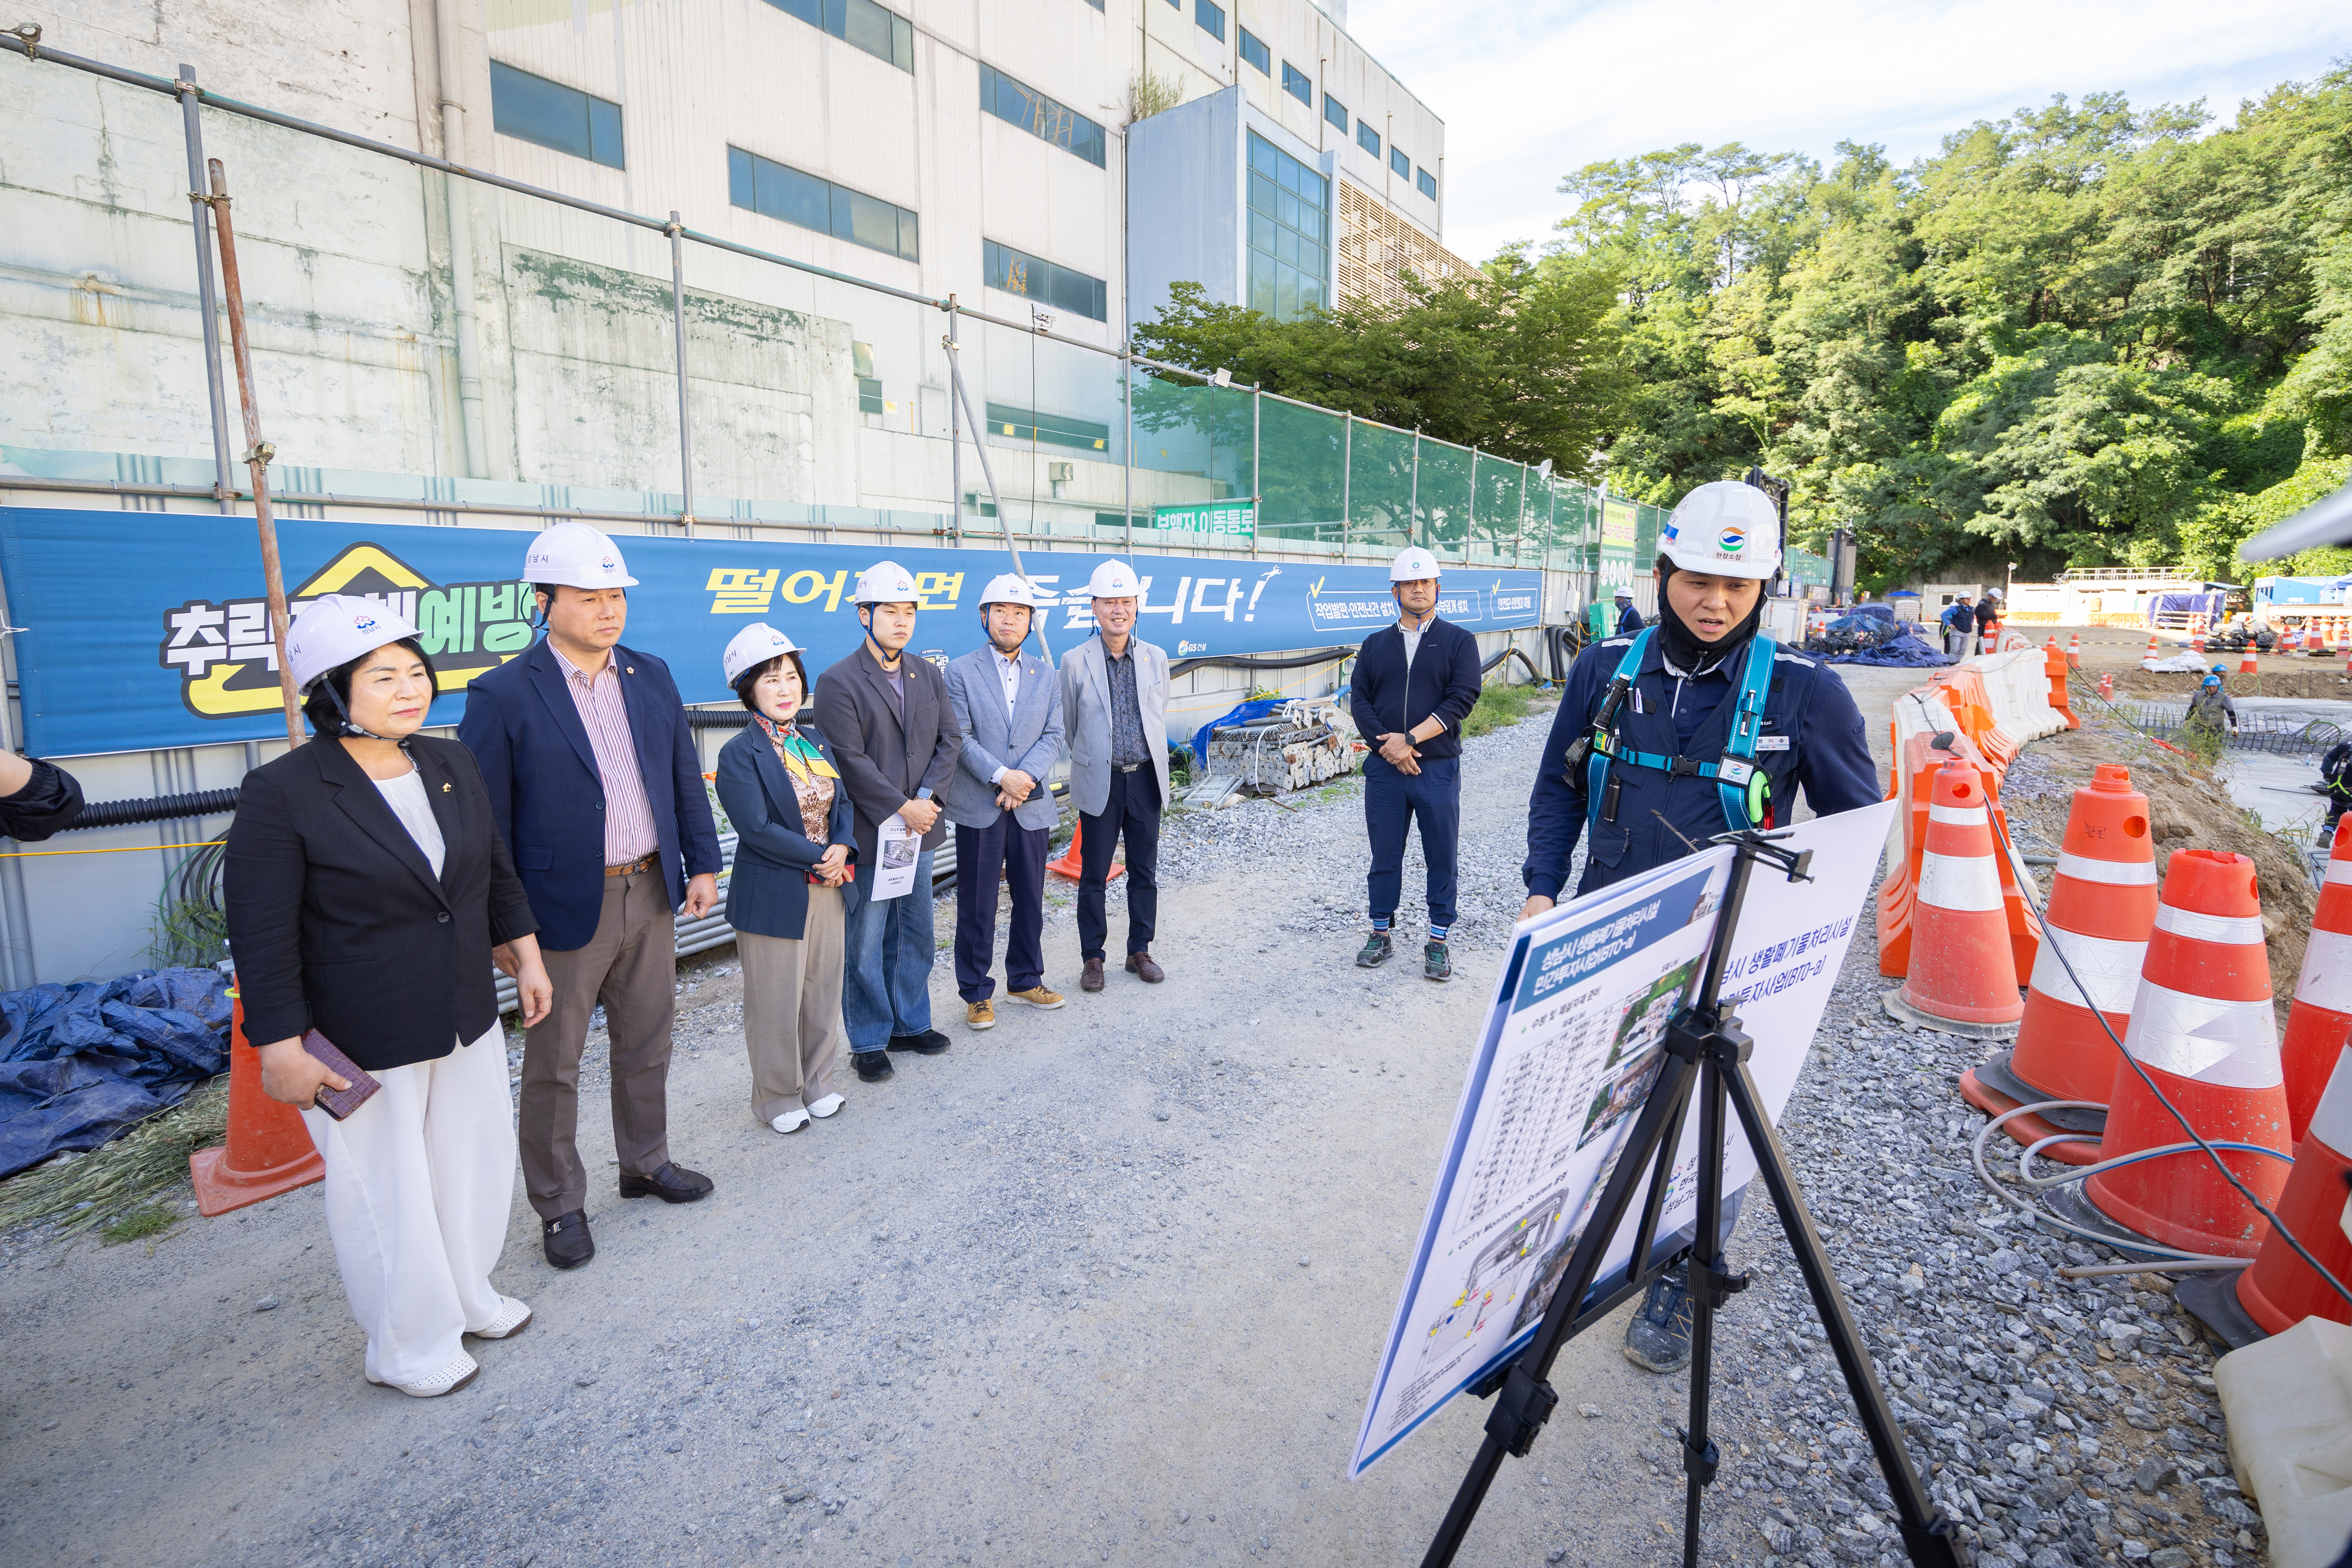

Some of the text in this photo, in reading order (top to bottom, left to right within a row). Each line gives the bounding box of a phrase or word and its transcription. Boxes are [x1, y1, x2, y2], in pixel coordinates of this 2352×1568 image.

[1199, 509, 1253, 534] 이동통로
[527, 554, 548, 563] 성남시
[1716, 552, 1742, 561] 현장소장
[705, 568, 965, 614] 떨어면
[1380, 601, 1397, 616] 설치
[1457, 599, 1469, 613] 설치
[1523, 596, 1531, 608] 착용
[168, 583, 537, 675] 추락예방
[362, 624, 382, 635] 성남시
[1540, 938, 1578, 971] 성남시
[1720, 915, 1853, 985] 남시 생활폐기물처리시설
[1458, 1228, 1483, 1250] CCTV
[1483, 1201, 1525, 1233] Monitoring
[1527, 1182, 1553, 1204] System
